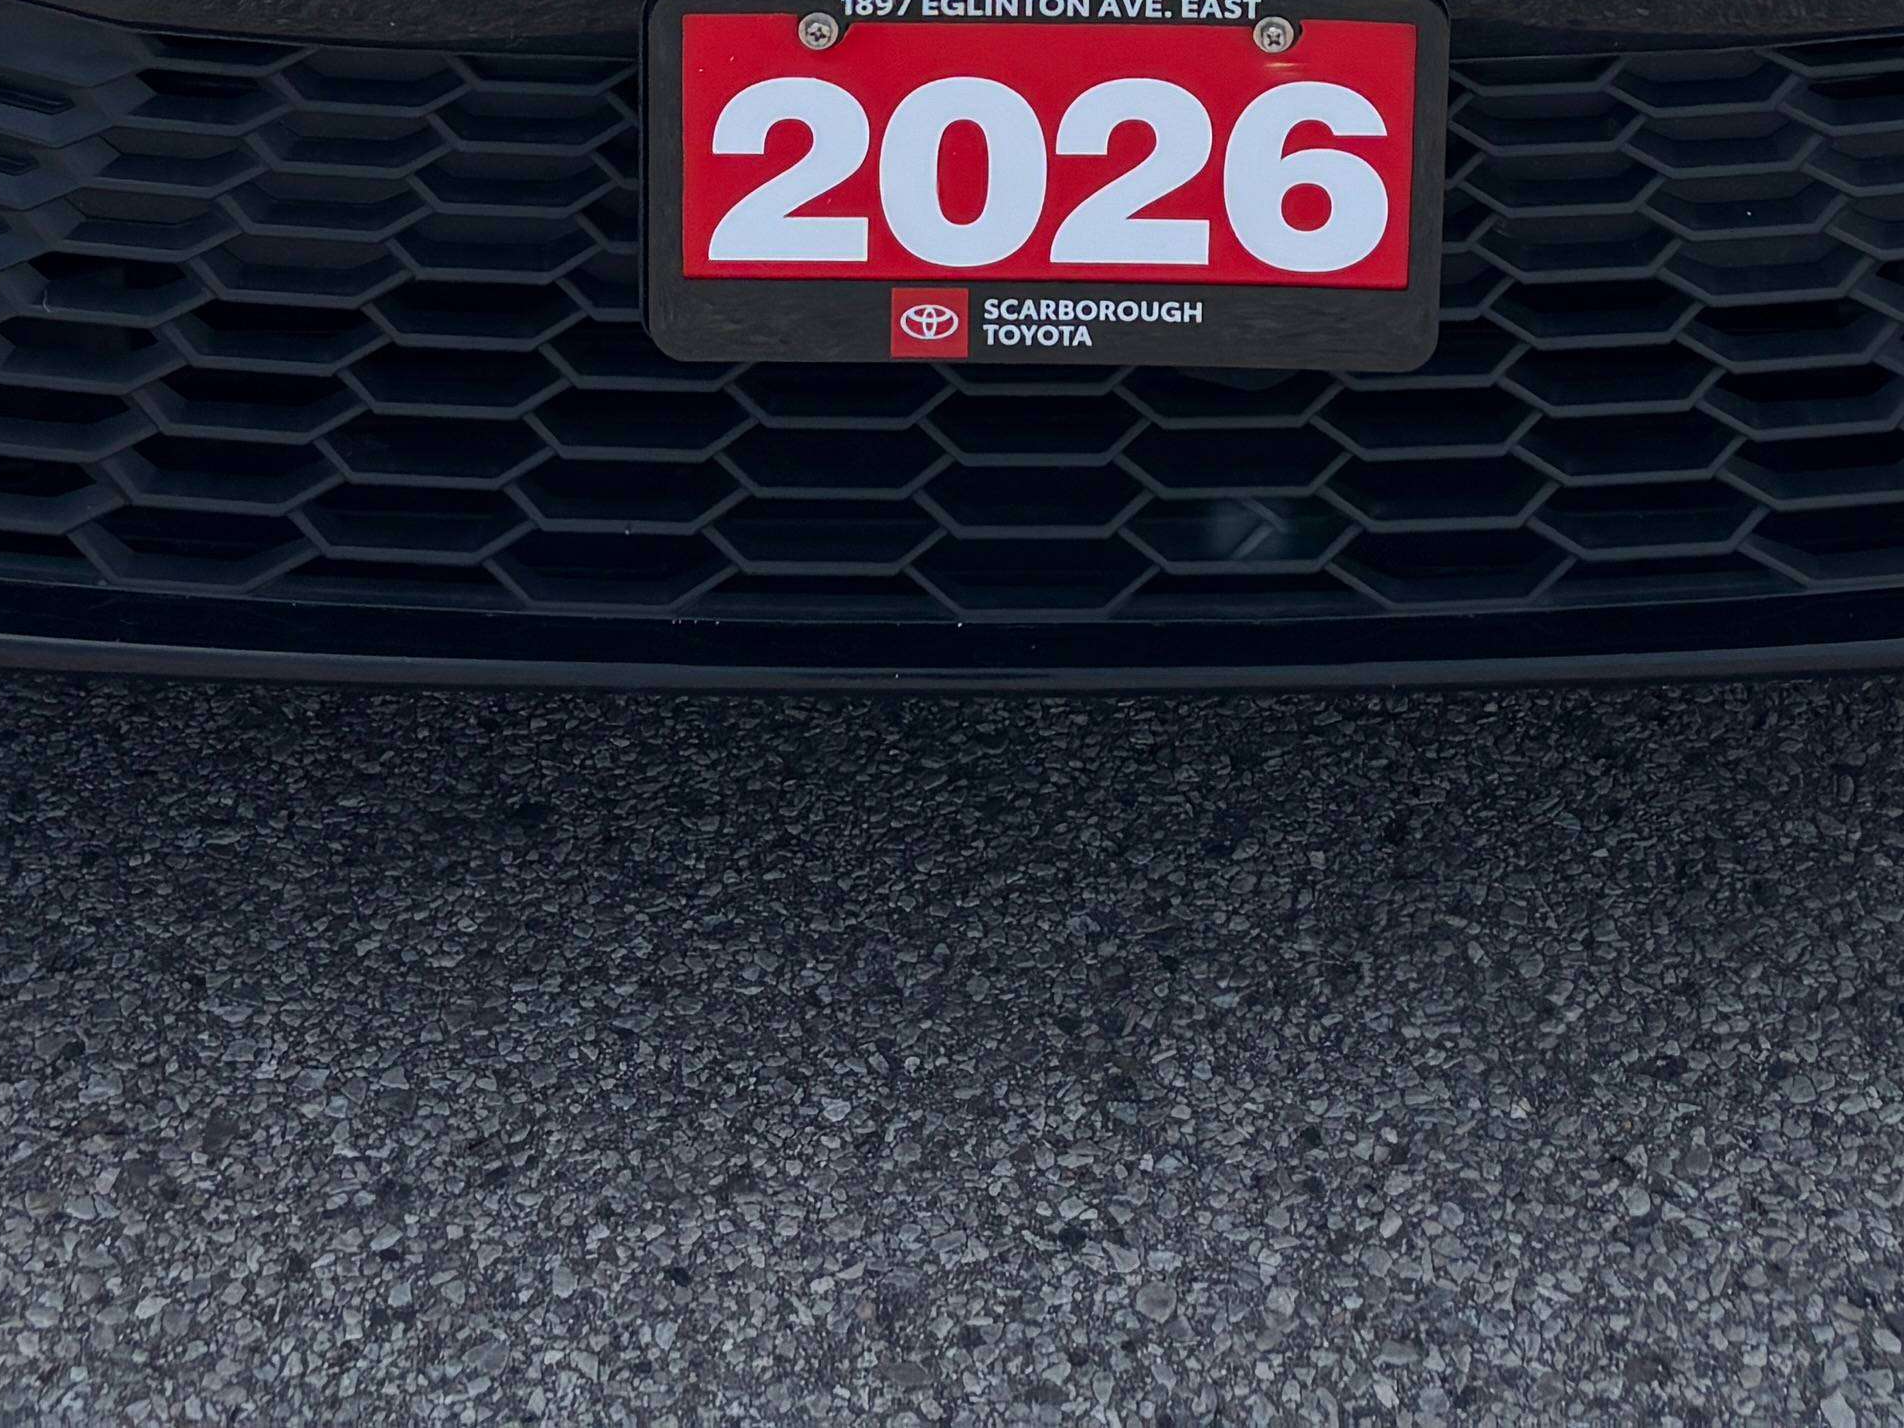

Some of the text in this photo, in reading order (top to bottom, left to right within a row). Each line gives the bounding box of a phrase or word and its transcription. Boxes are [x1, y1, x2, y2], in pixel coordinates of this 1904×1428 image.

[707, 76, 1389, 272] 2026
[983, 299, 1203, 323] SCARBOROUGH
[983, 324, 1093, 346] TOYOTA
